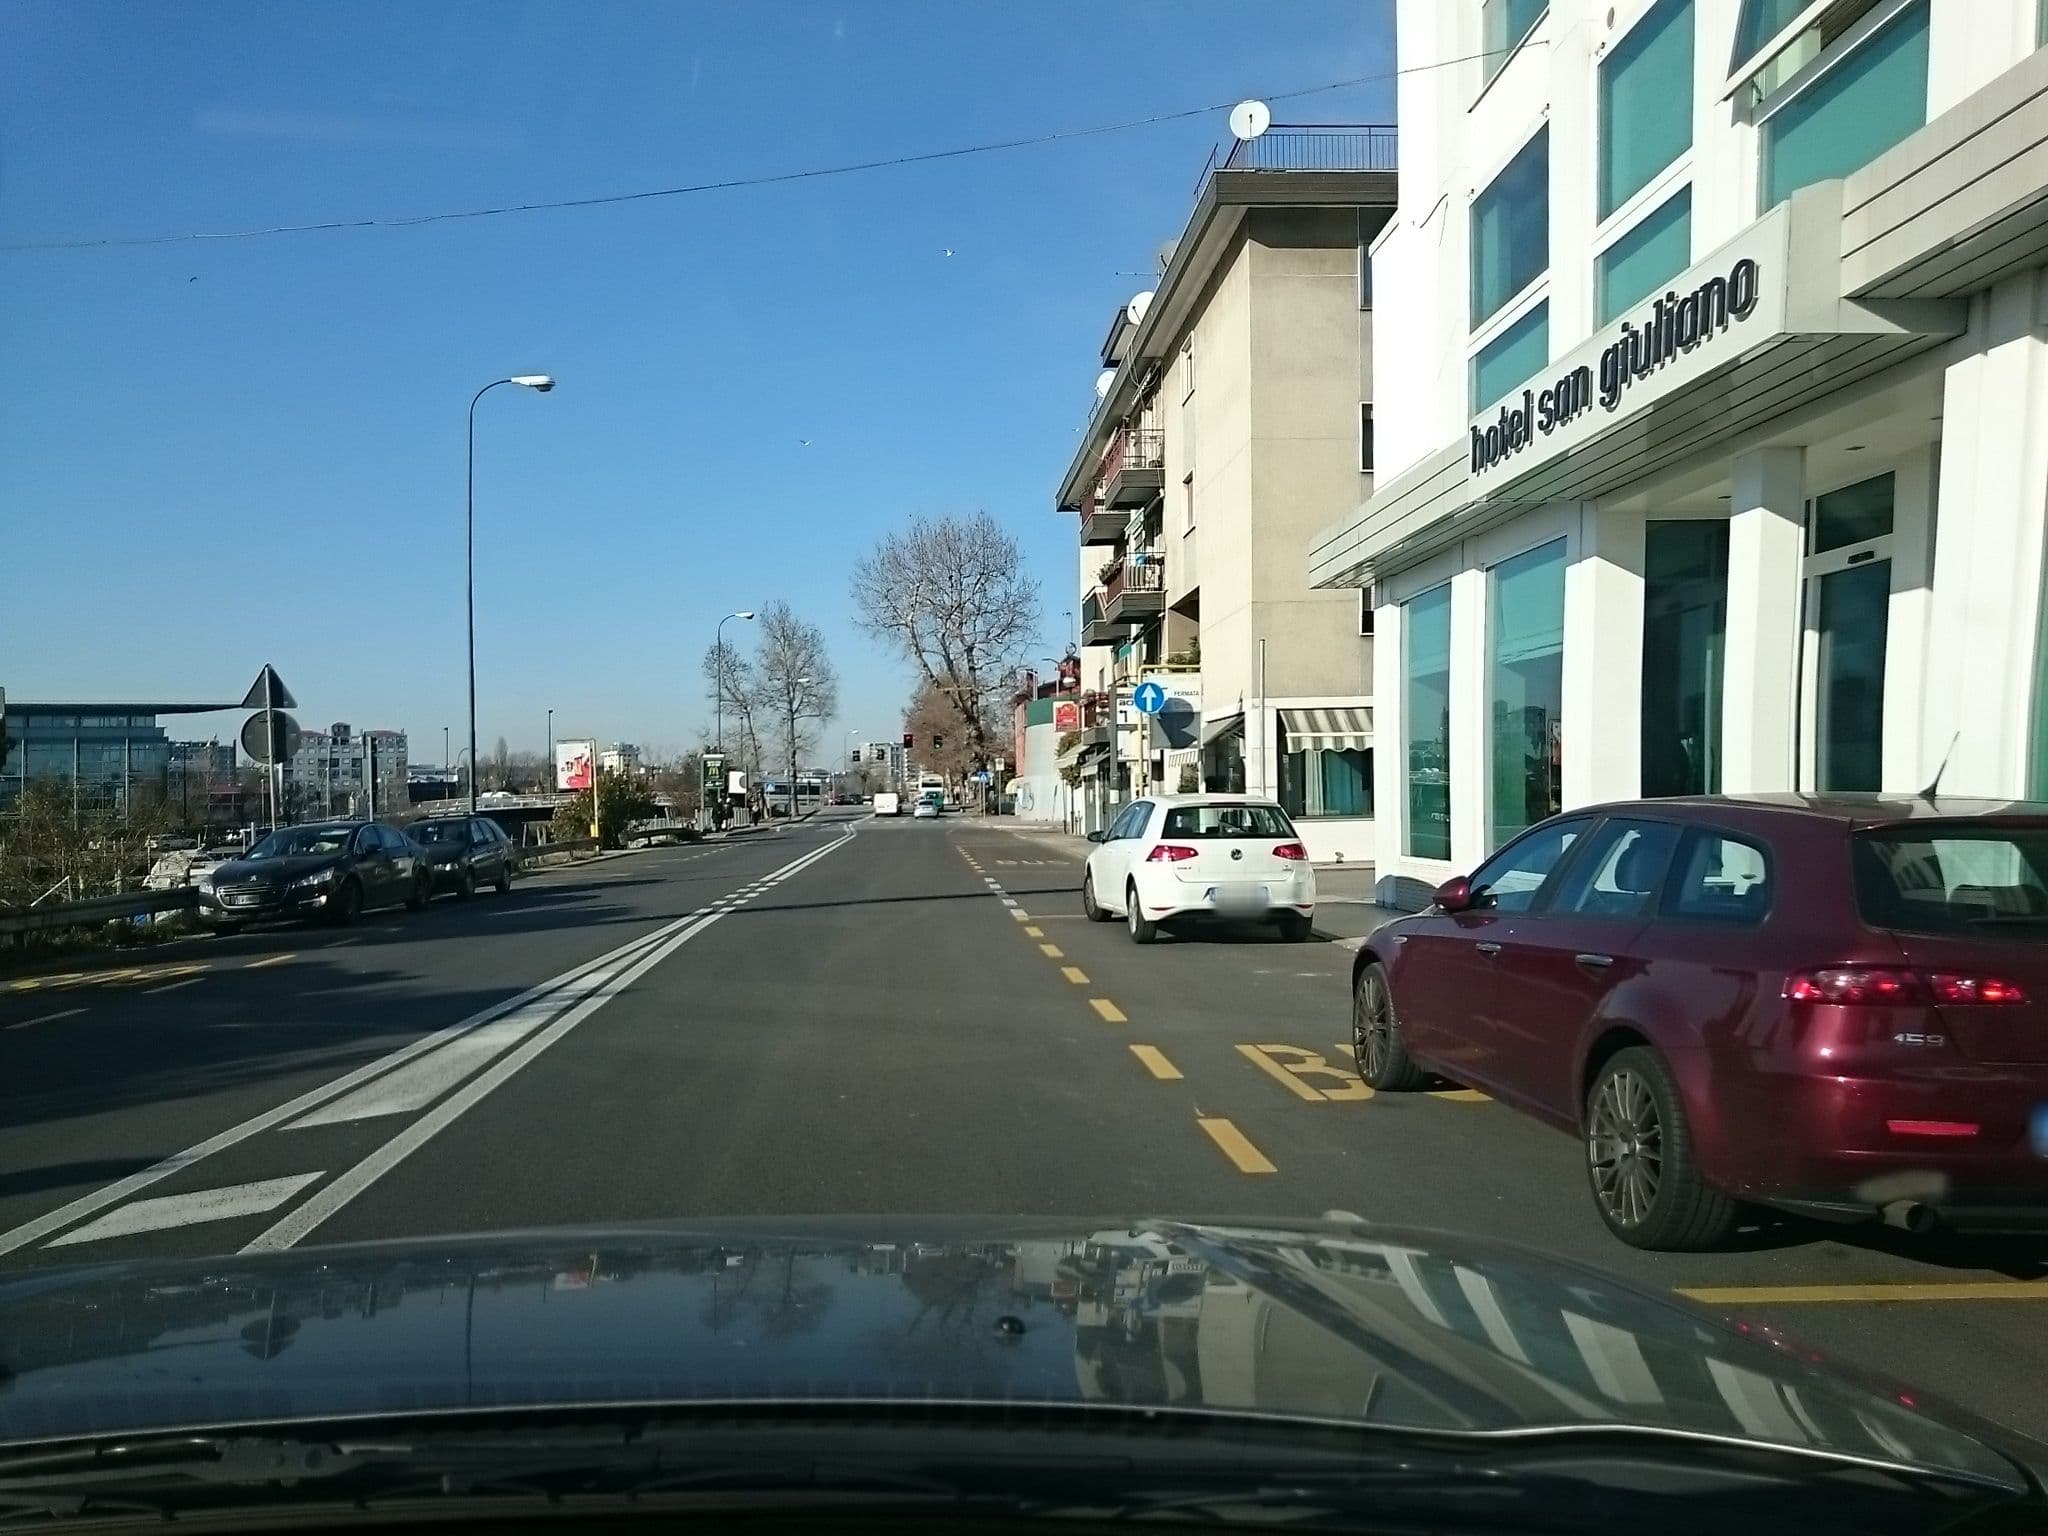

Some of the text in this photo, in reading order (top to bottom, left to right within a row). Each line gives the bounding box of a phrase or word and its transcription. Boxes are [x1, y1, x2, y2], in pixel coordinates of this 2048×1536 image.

[1470, 258, 1760, 475] hotel san giuliano
